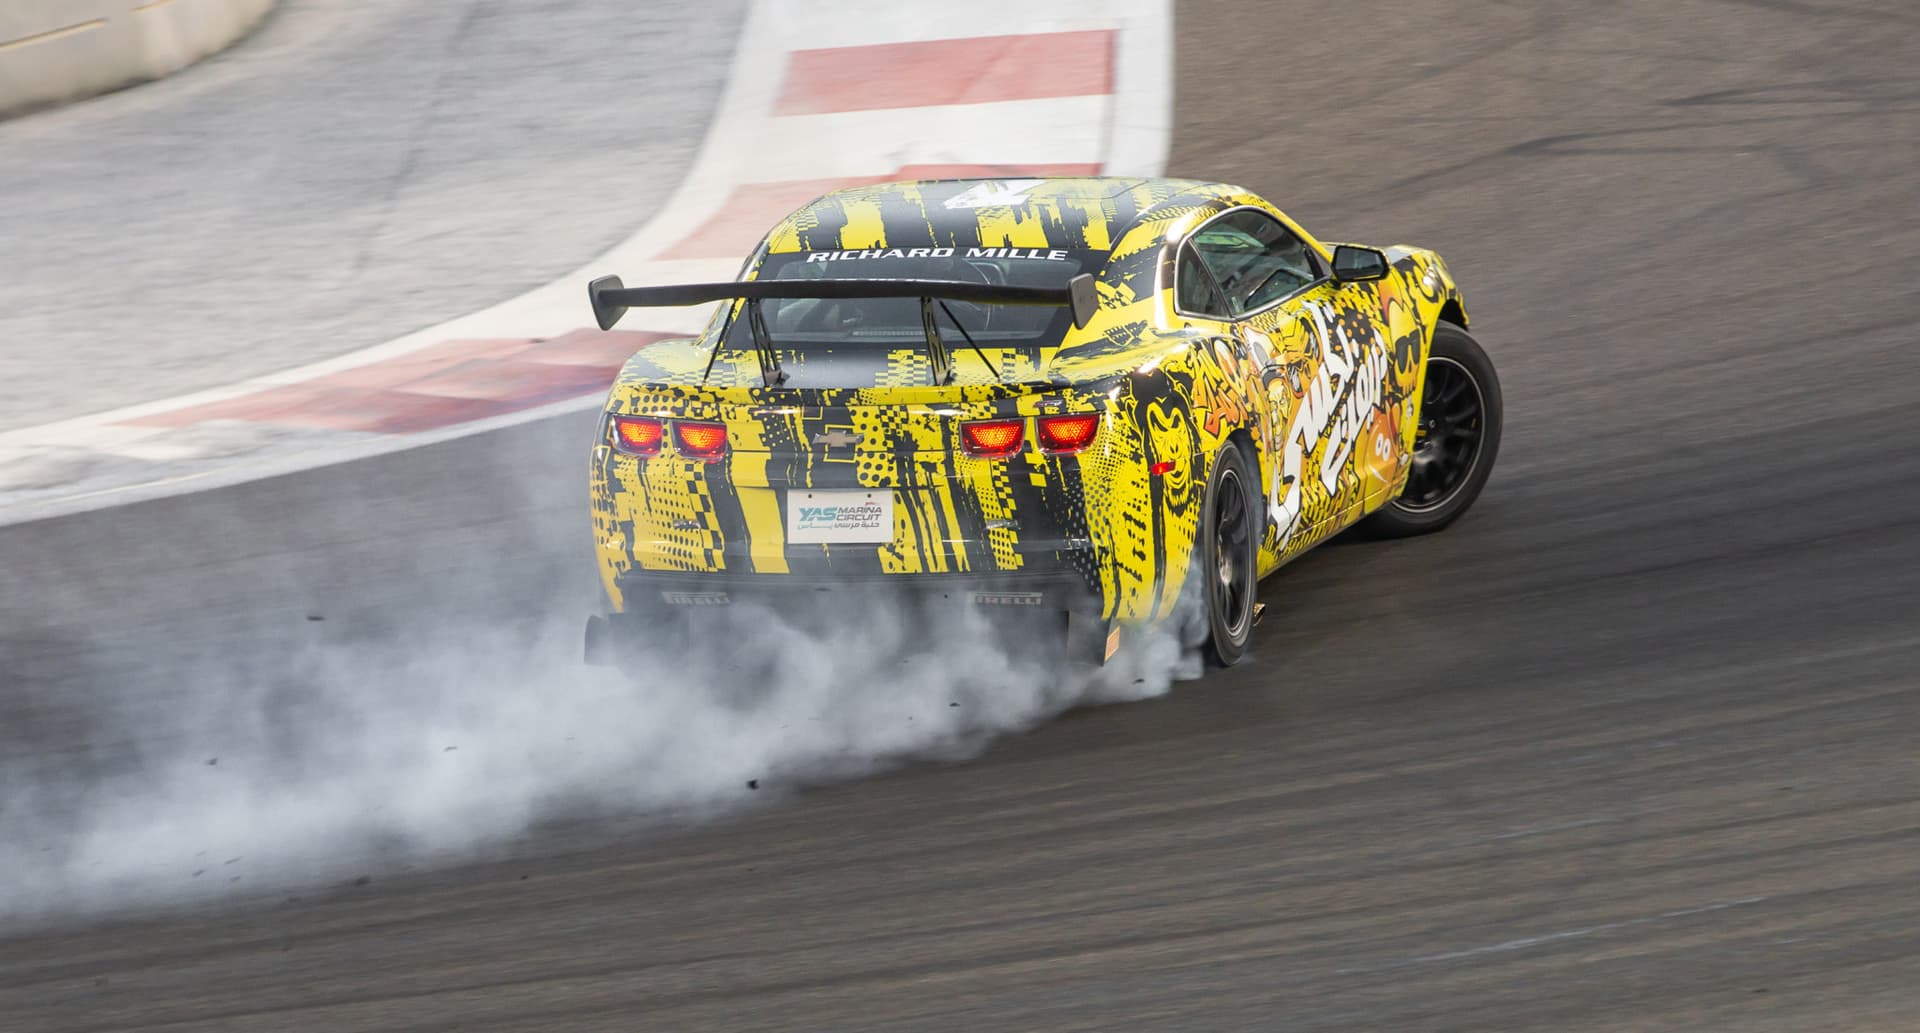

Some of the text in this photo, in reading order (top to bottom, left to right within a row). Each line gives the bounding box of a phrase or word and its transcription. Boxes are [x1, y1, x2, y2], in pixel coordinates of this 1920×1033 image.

[806, 247, 1069, 263] RICHARD MILLE
[799, 507, 838, 521] YAS
[661, 591, 730, 605] PIRELLI
[966, 591, 1043, 605] PIRELLI
